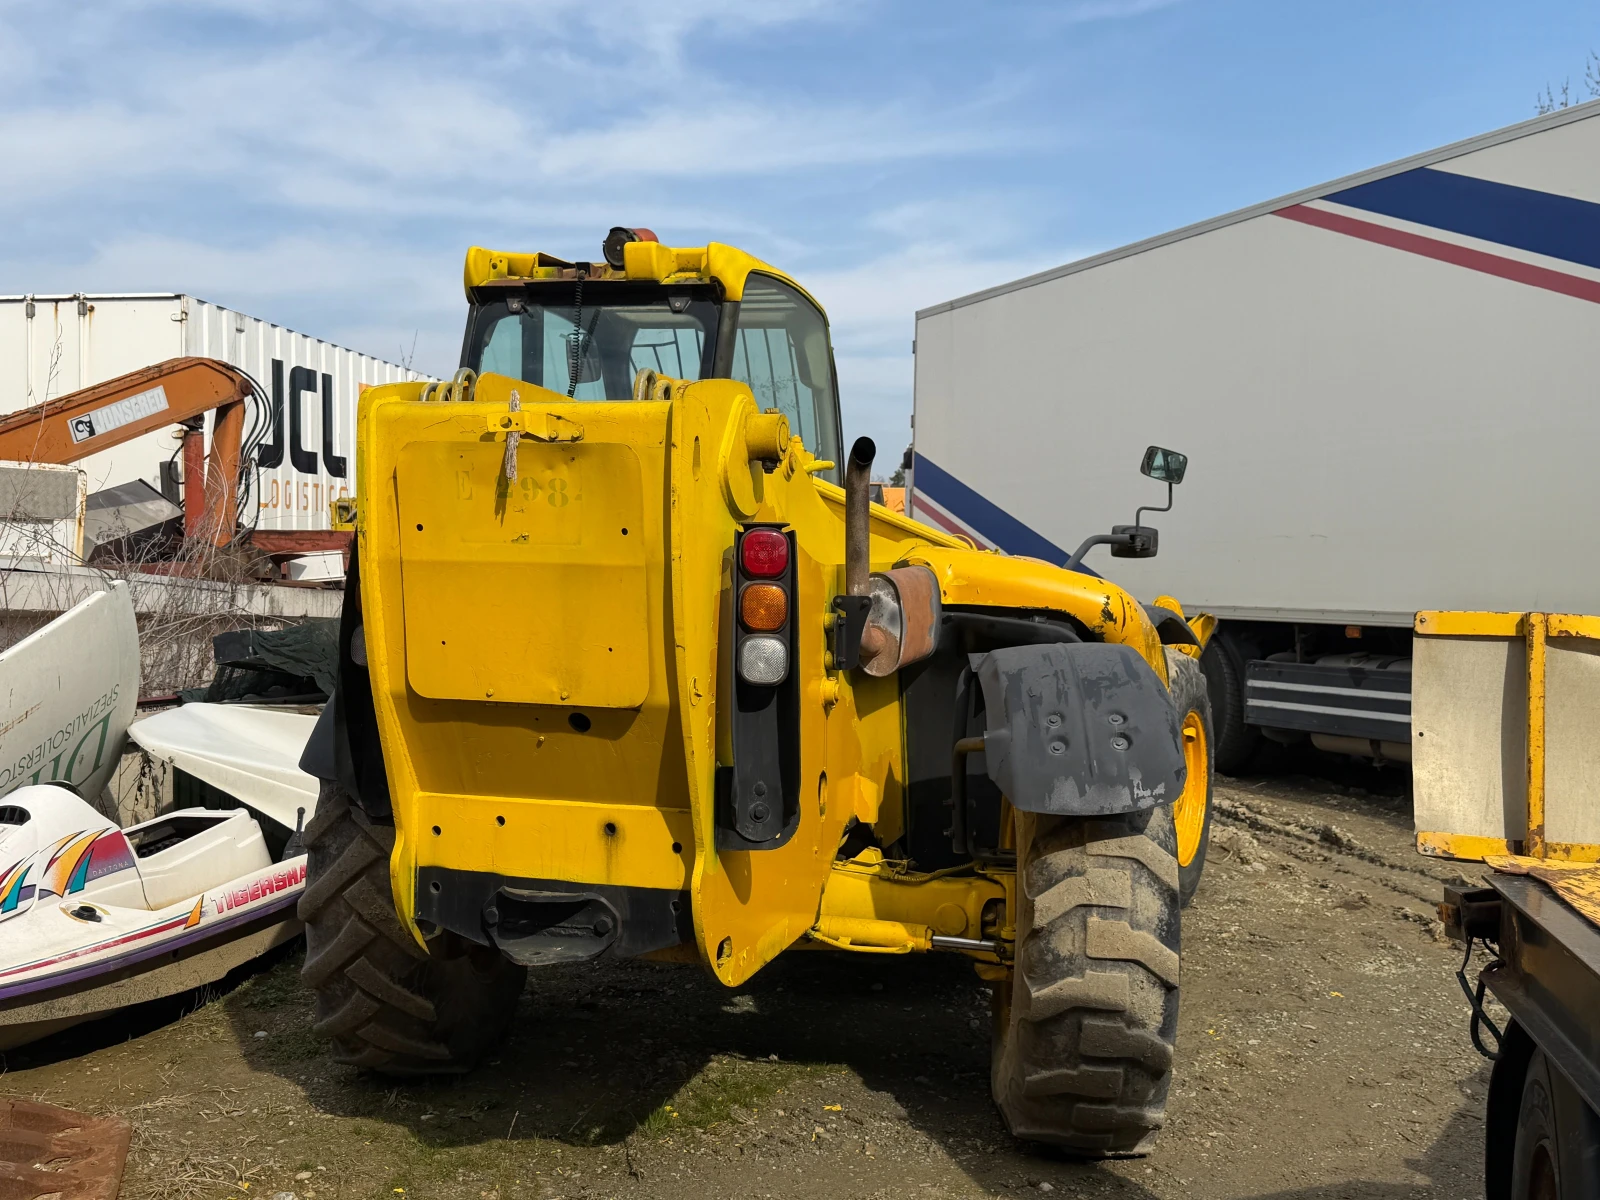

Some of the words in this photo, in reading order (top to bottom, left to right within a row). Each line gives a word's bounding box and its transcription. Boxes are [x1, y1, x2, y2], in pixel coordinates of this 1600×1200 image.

[94, 388, 166, 432] JONSERED
[258, 358, 347, 478] JCL
[260, 478, 349, 513] OGISTIC
[92, 860, 129, 877] DAYTONA
